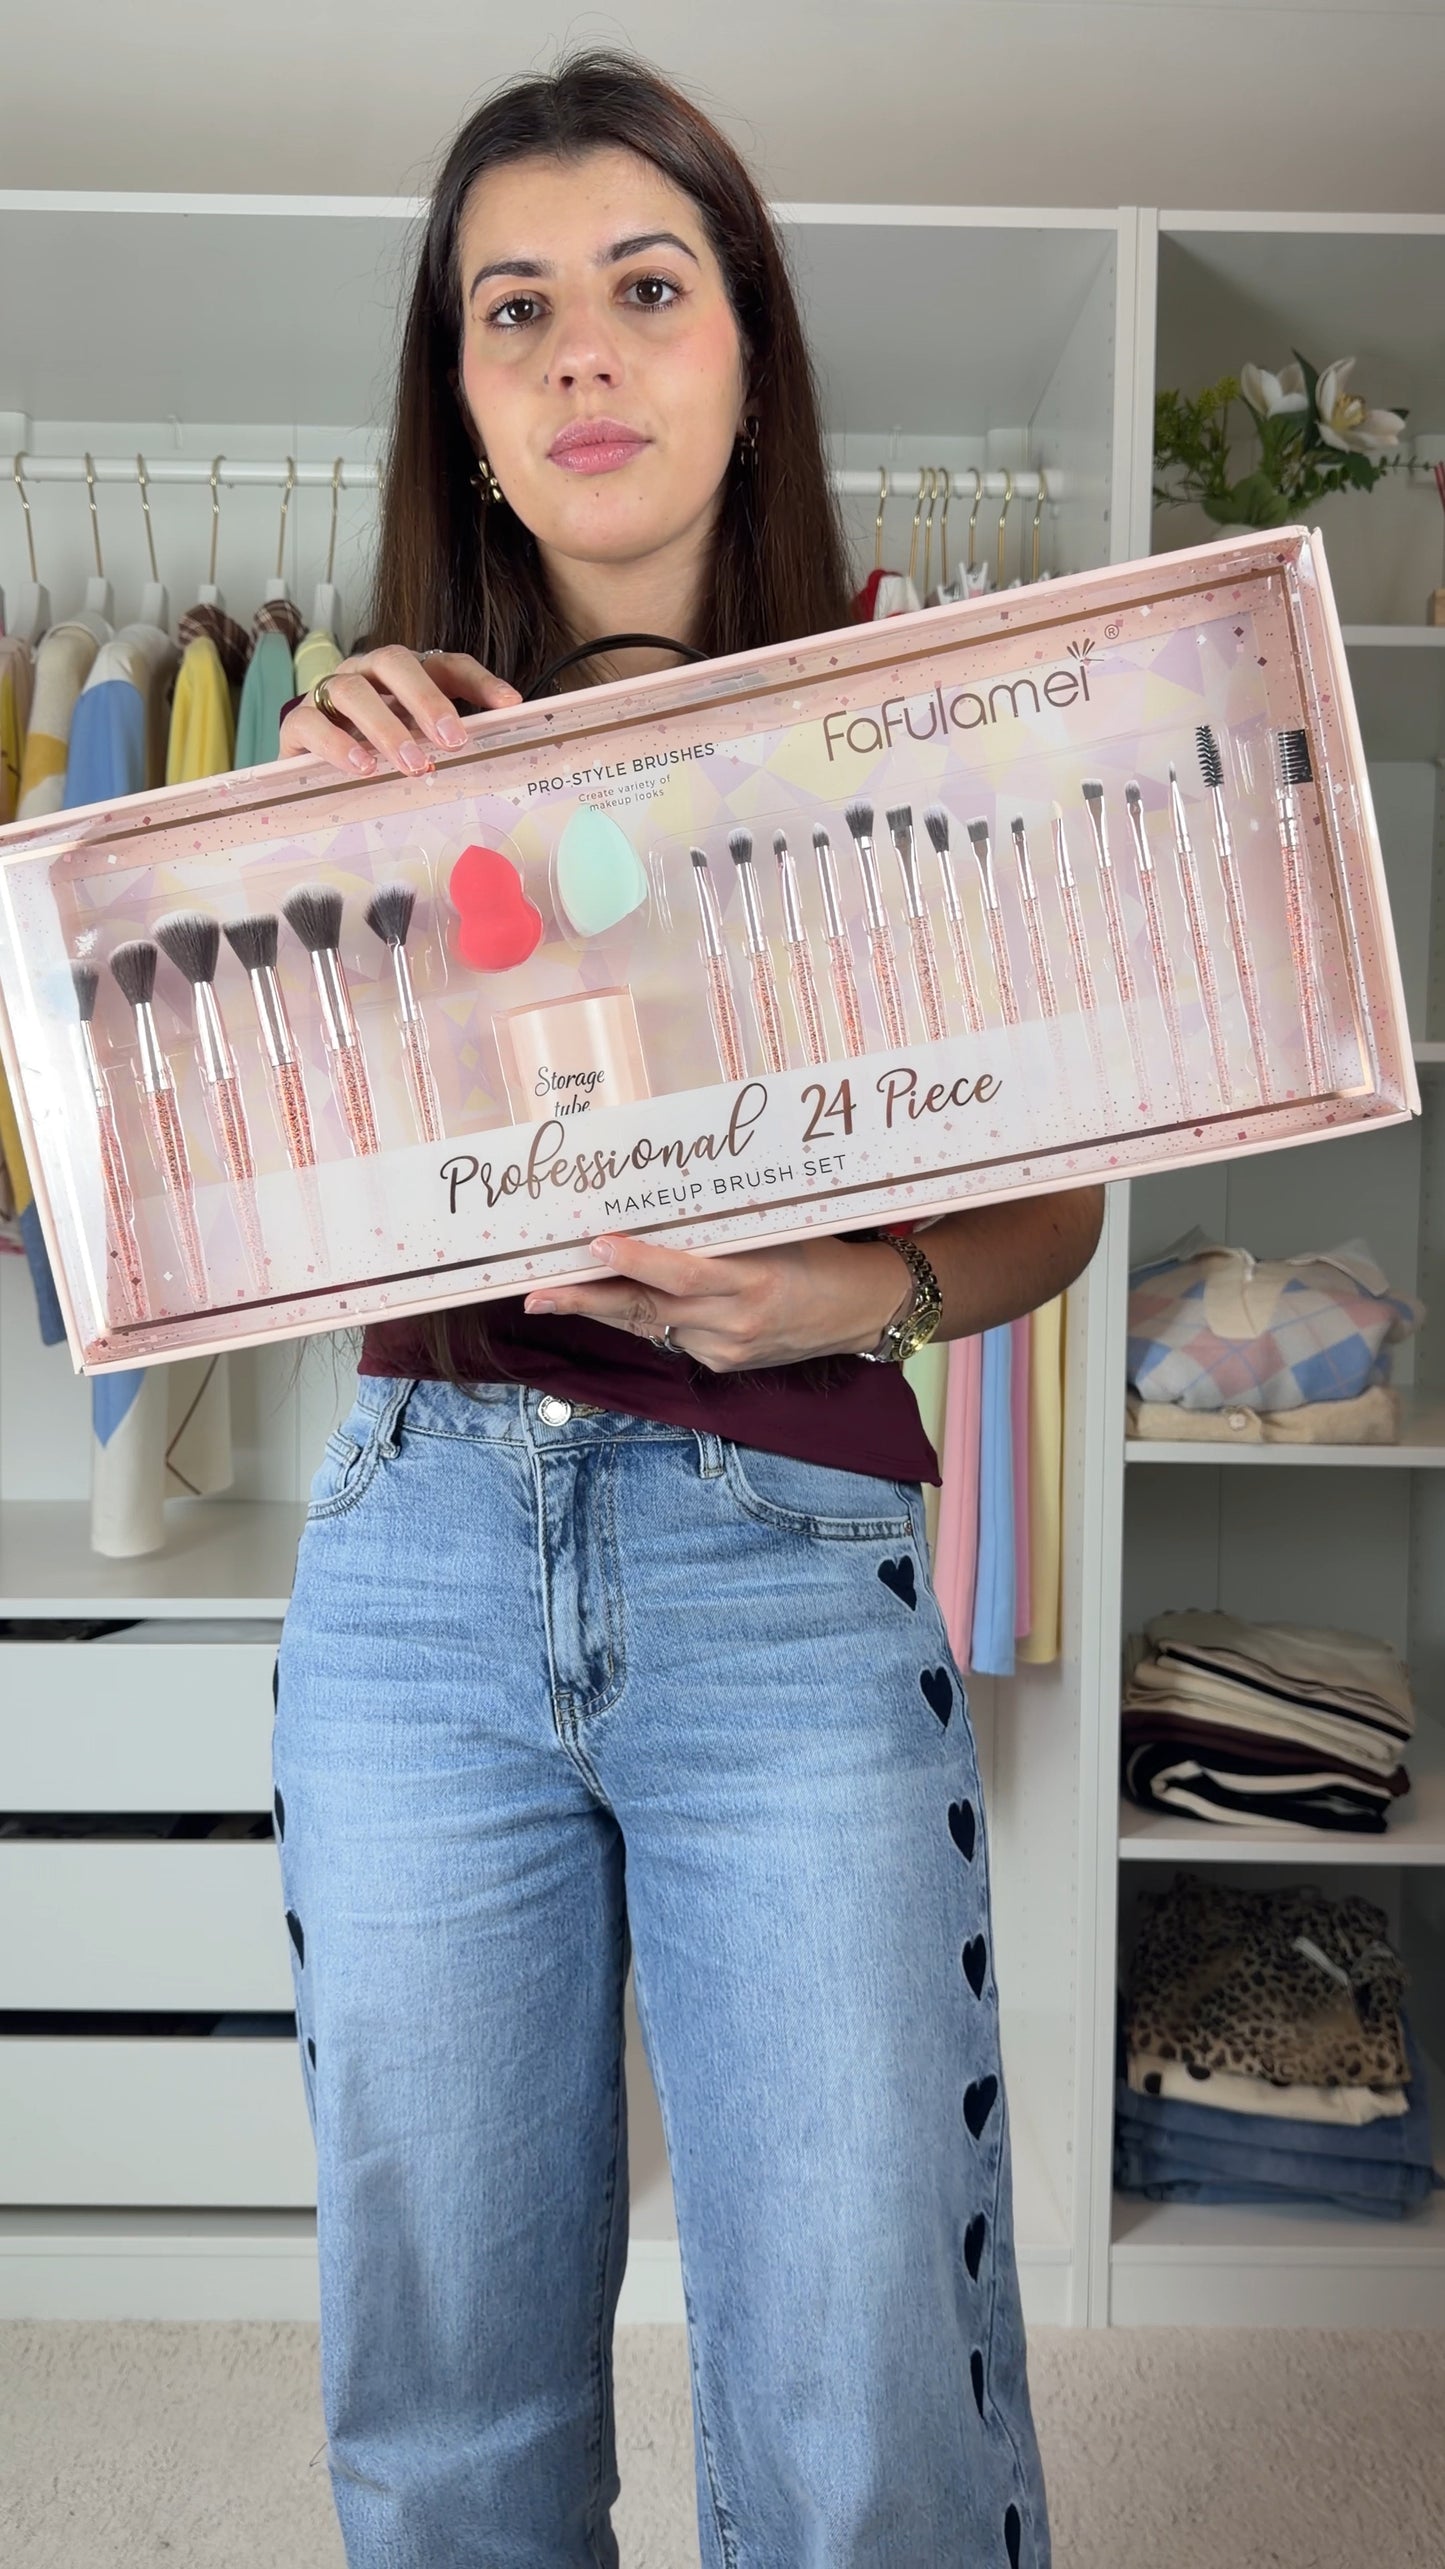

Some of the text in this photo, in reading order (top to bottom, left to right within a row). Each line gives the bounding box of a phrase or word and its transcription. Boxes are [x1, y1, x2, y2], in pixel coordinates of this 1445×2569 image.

[527, 742, 715, 796] PRO-STYLE BRUSHES
[578, 774, 671, 802] Create variety of
[589, 788, 665, 812] makeup looks
[534, 1065, 605, 1097] Storage
[440, 1067, 1002, 1214] Professional 24 Piece
[604, 1154, 848, 1217] MAKEUP BRUSH SET
